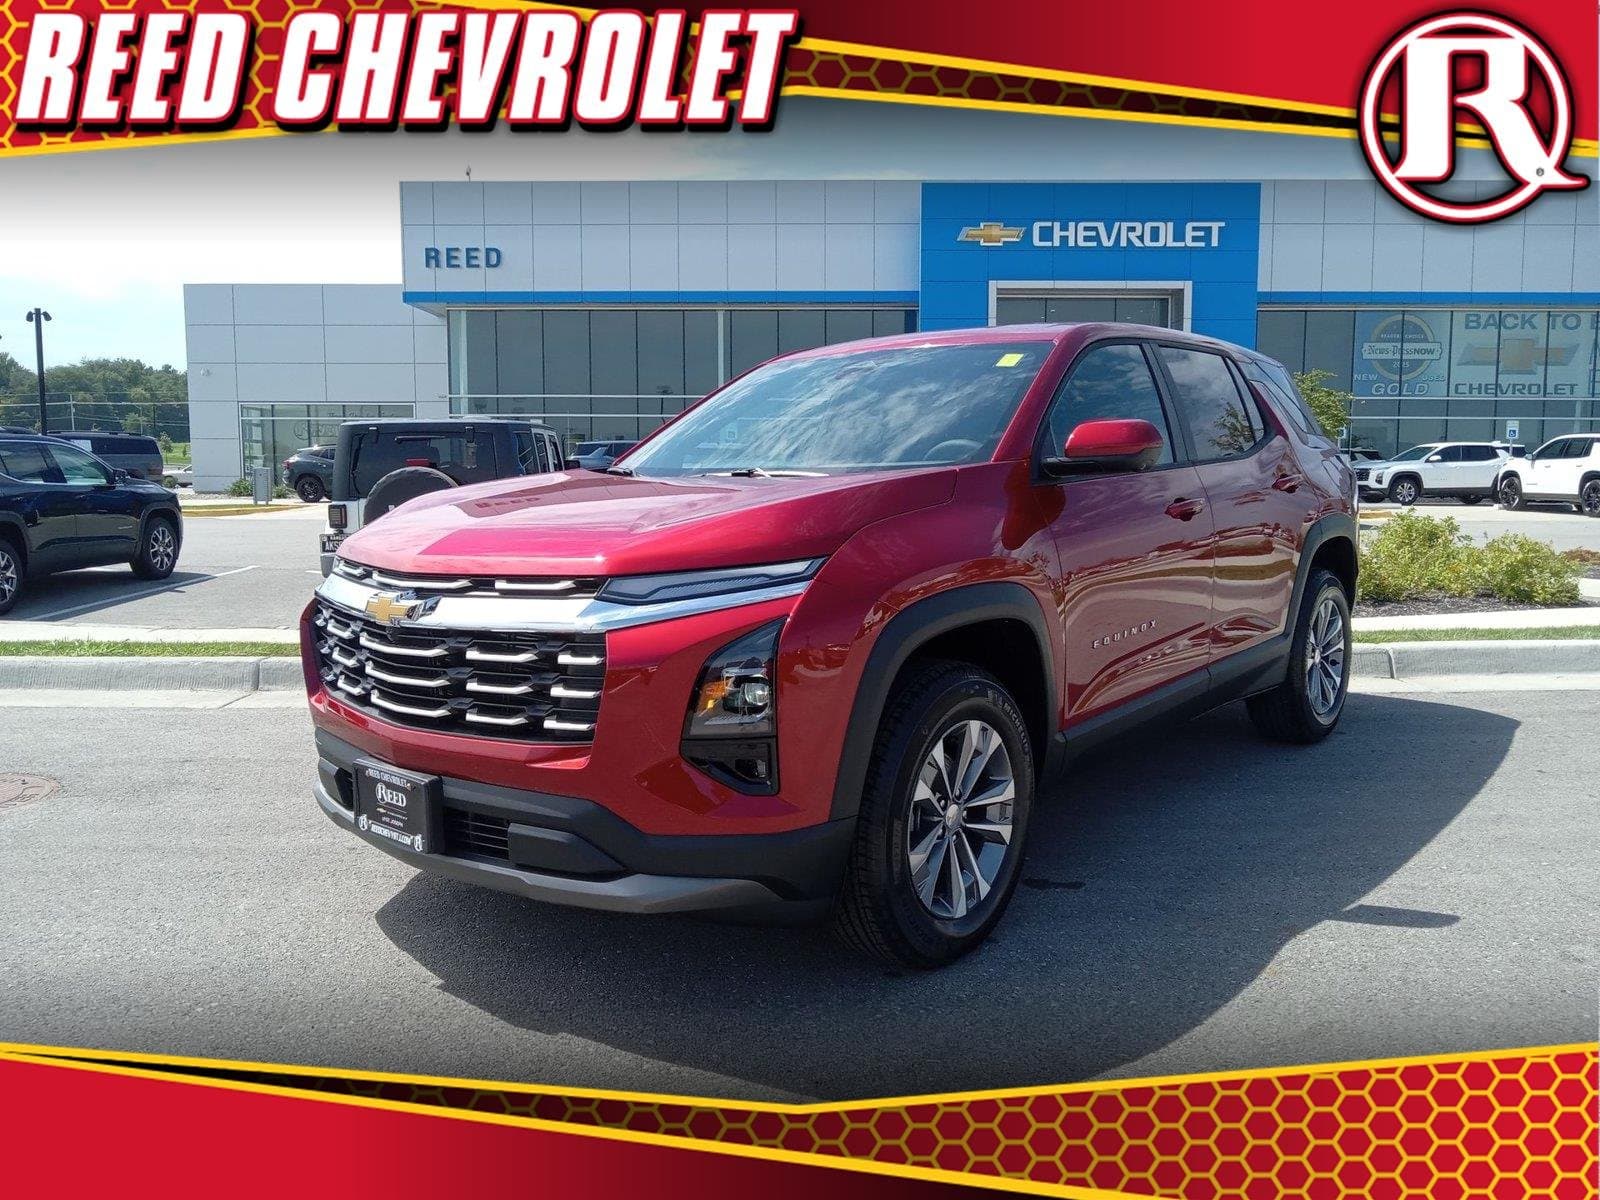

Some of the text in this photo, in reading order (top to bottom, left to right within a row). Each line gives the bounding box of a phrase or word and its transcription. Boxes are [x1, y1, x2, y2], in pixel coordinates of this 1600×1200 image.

[1032, 221, 1226, 248] CHEVROLET
[424, 247, 502, 269] REED
[1464, 313, 1538, 330] BACK
[1548, 313, 1582, 330] TO
[1371, 383, 1429, 396] GOLD
[1454, 383, 1579, 395] CHEVROLET
[1092, 619, 1157, 649] EQUINOX
[375, 782, 407, 808] REED
